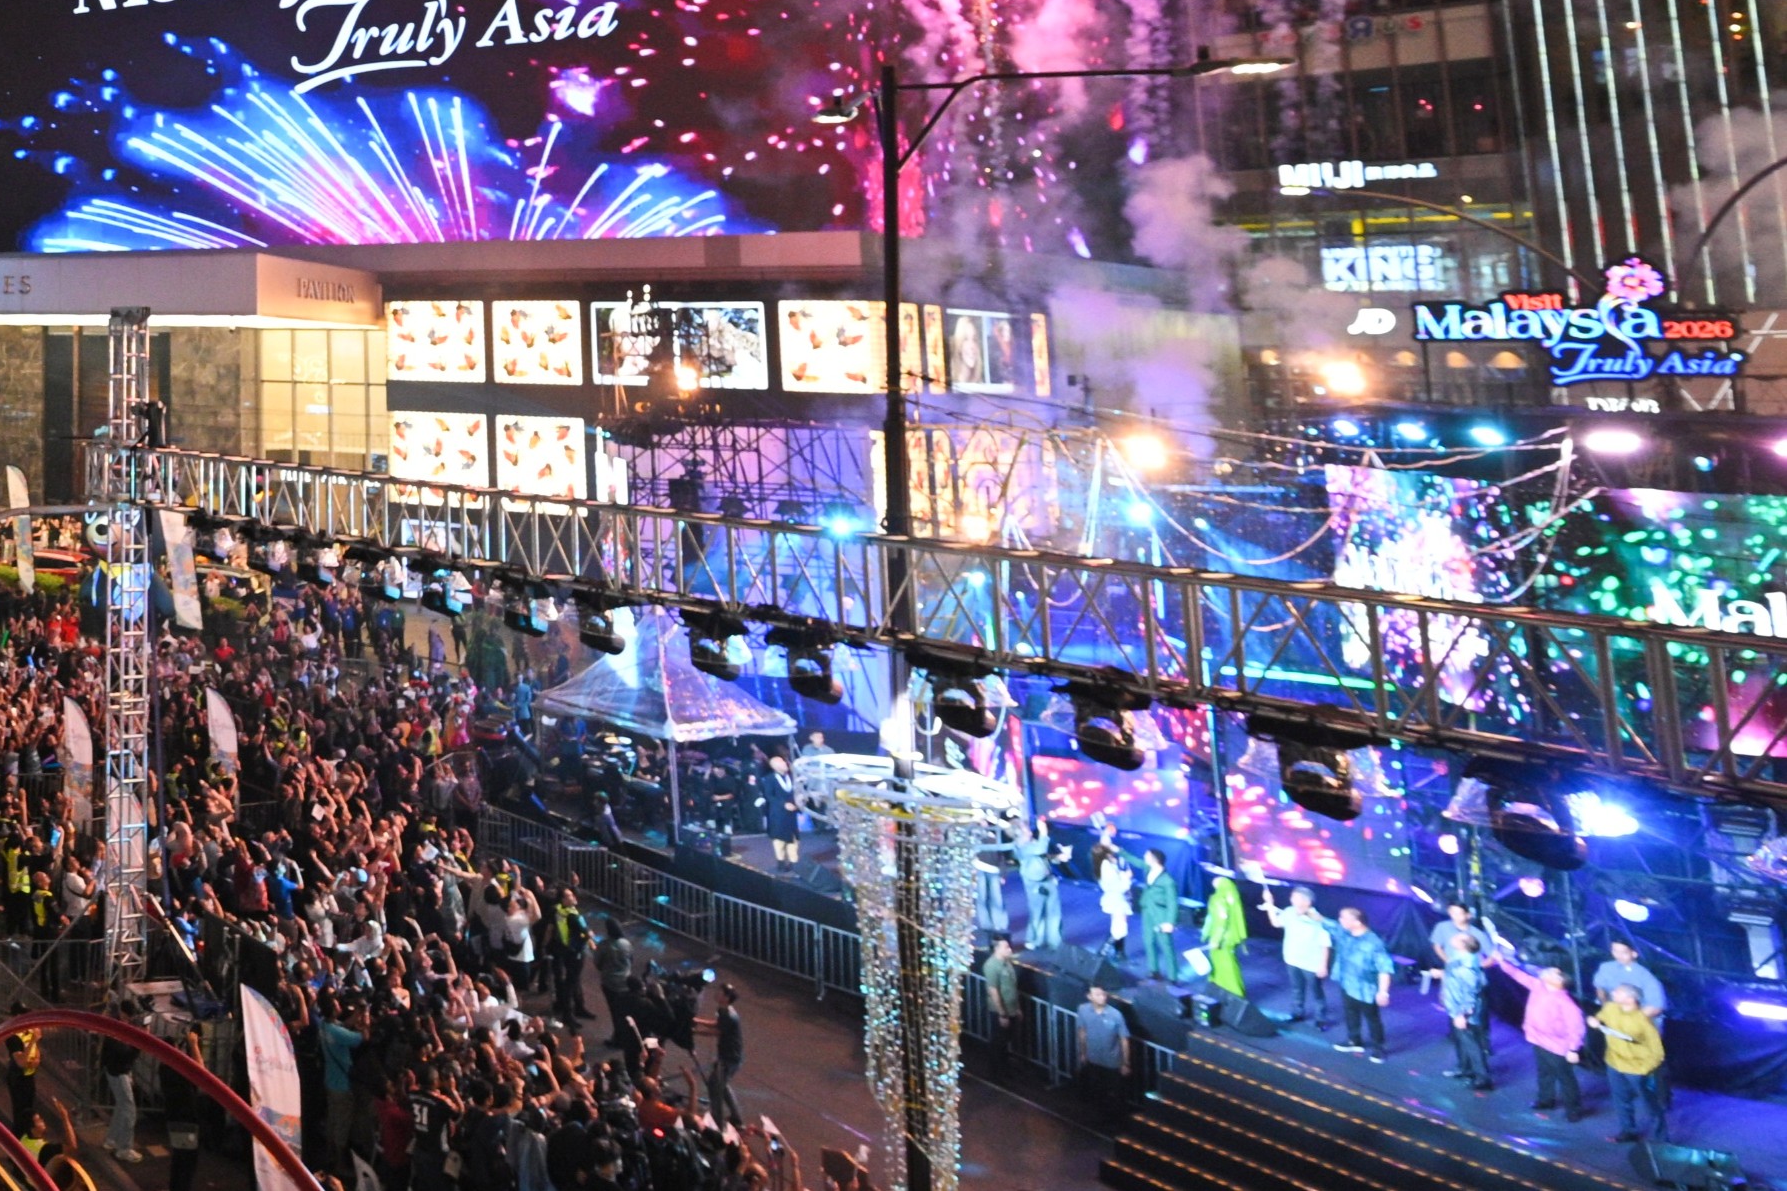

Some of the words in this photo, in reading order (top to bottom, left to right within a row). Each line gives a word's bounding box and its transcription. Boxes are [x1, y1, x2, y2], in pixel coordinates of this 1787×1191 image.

[297, 278, 356, 304] PAVILION
[1347, 307, 1397, 336] JD
[1416, 299, 1663, 347] Malaysia
[1664, 320, 1734, 340] 2026
[1550, 342, 1654, 385] Truly
[1657, 351, 1738, 376] Asia
